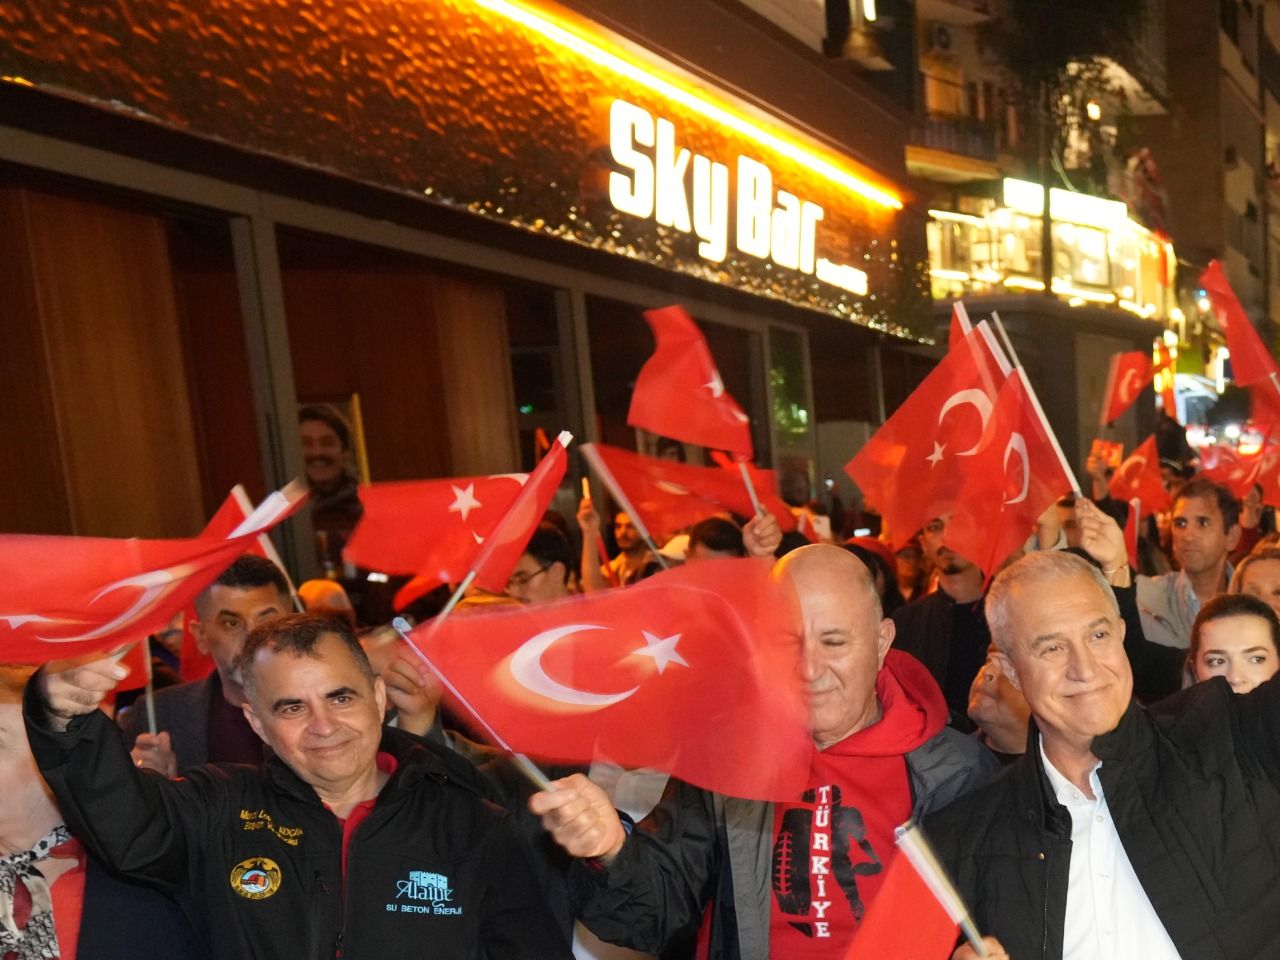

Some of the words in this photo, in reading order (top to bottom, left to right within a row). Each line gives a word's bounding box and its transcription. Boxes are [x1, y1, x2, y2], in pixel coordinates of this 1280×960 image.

[609, 98, 729, 264] Sky
[735, 154, 825, 275] Bar
[386, 903, 398, 912] SU
[401, 904, 430, 914] BETON
[811, 785, 831, 938] TÜRKİYE
